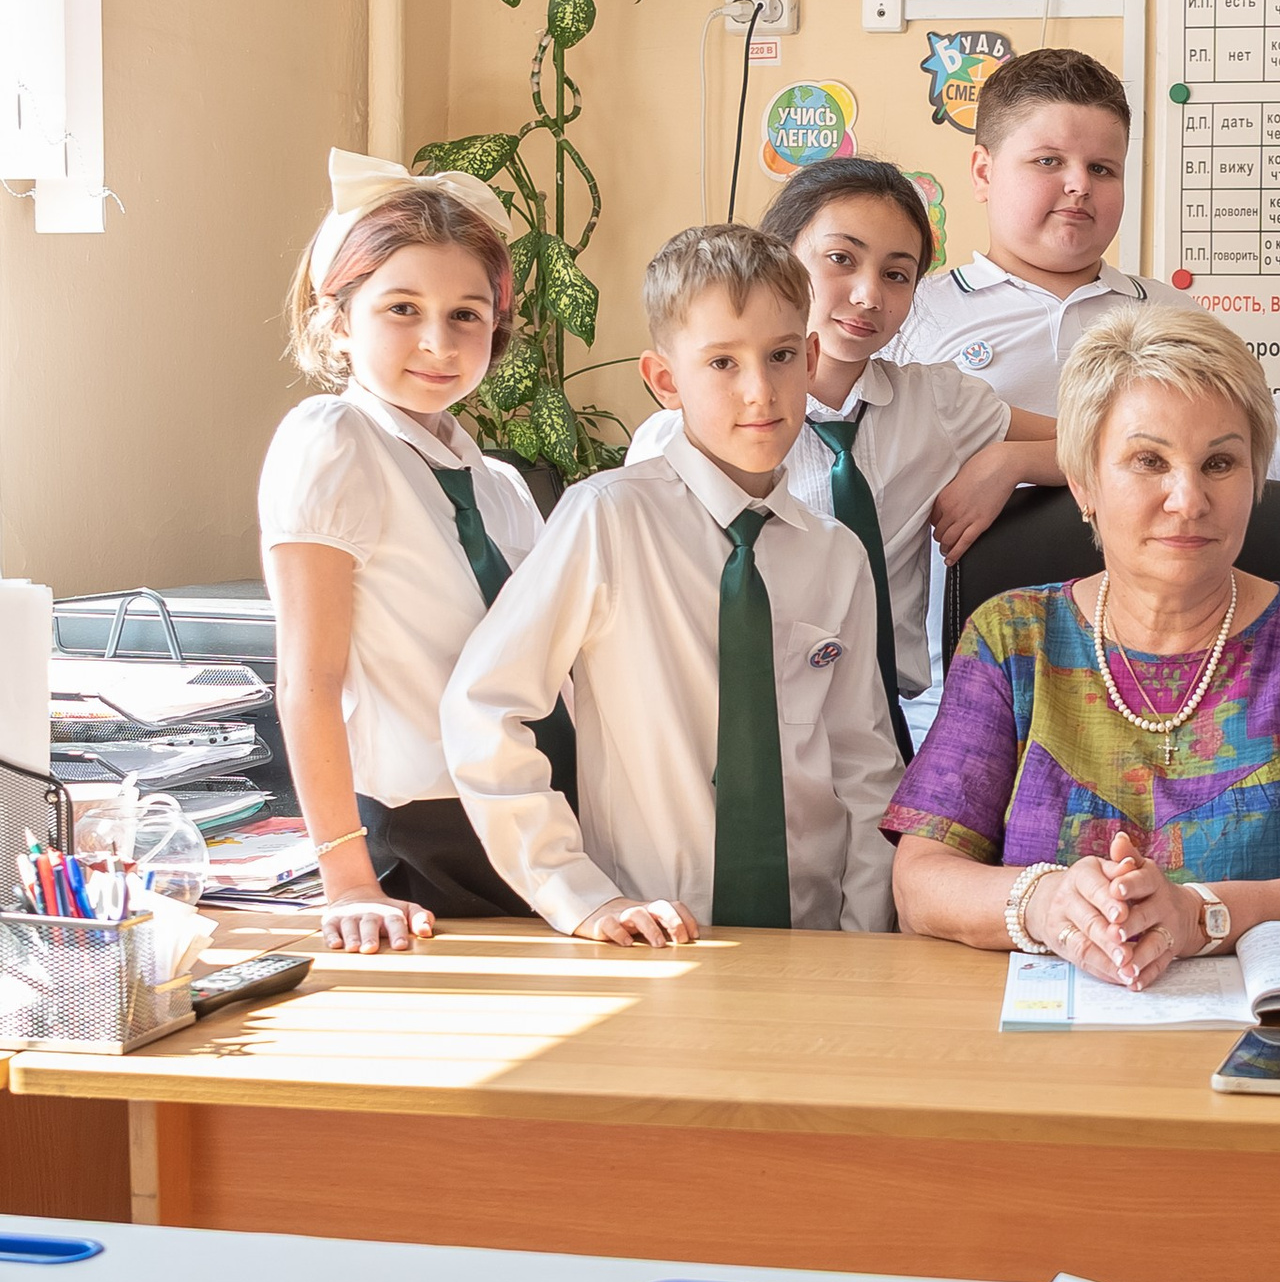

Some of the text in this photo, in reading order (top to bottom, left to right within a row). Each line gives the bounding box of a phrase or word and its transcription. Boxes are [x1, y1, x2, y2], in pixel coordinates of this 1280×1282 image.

[935, 34, 1004, 74] БУДЬ
[1189, 49, 1211, 62] Р.П.
[1228, 50, 1251, 61] нет
[777, 108, 837, 126] УЧИСЬ
[1186, 116, 1210, 131] Д.П.
[1221, 117, 1253, 130] дать
[776, 130, 838, 148] ЛЕГКО!
[1186, 161, 1210, 174] В.П.
[1220, 162, 1254, 177] вижу
[1186, 205, 1208, 218] Т.П.
[1214, 206, 1258, 216] доволен
[1185, 248, 1209, 260] П.П.
[1214, 251, 1258, 262] говорить
